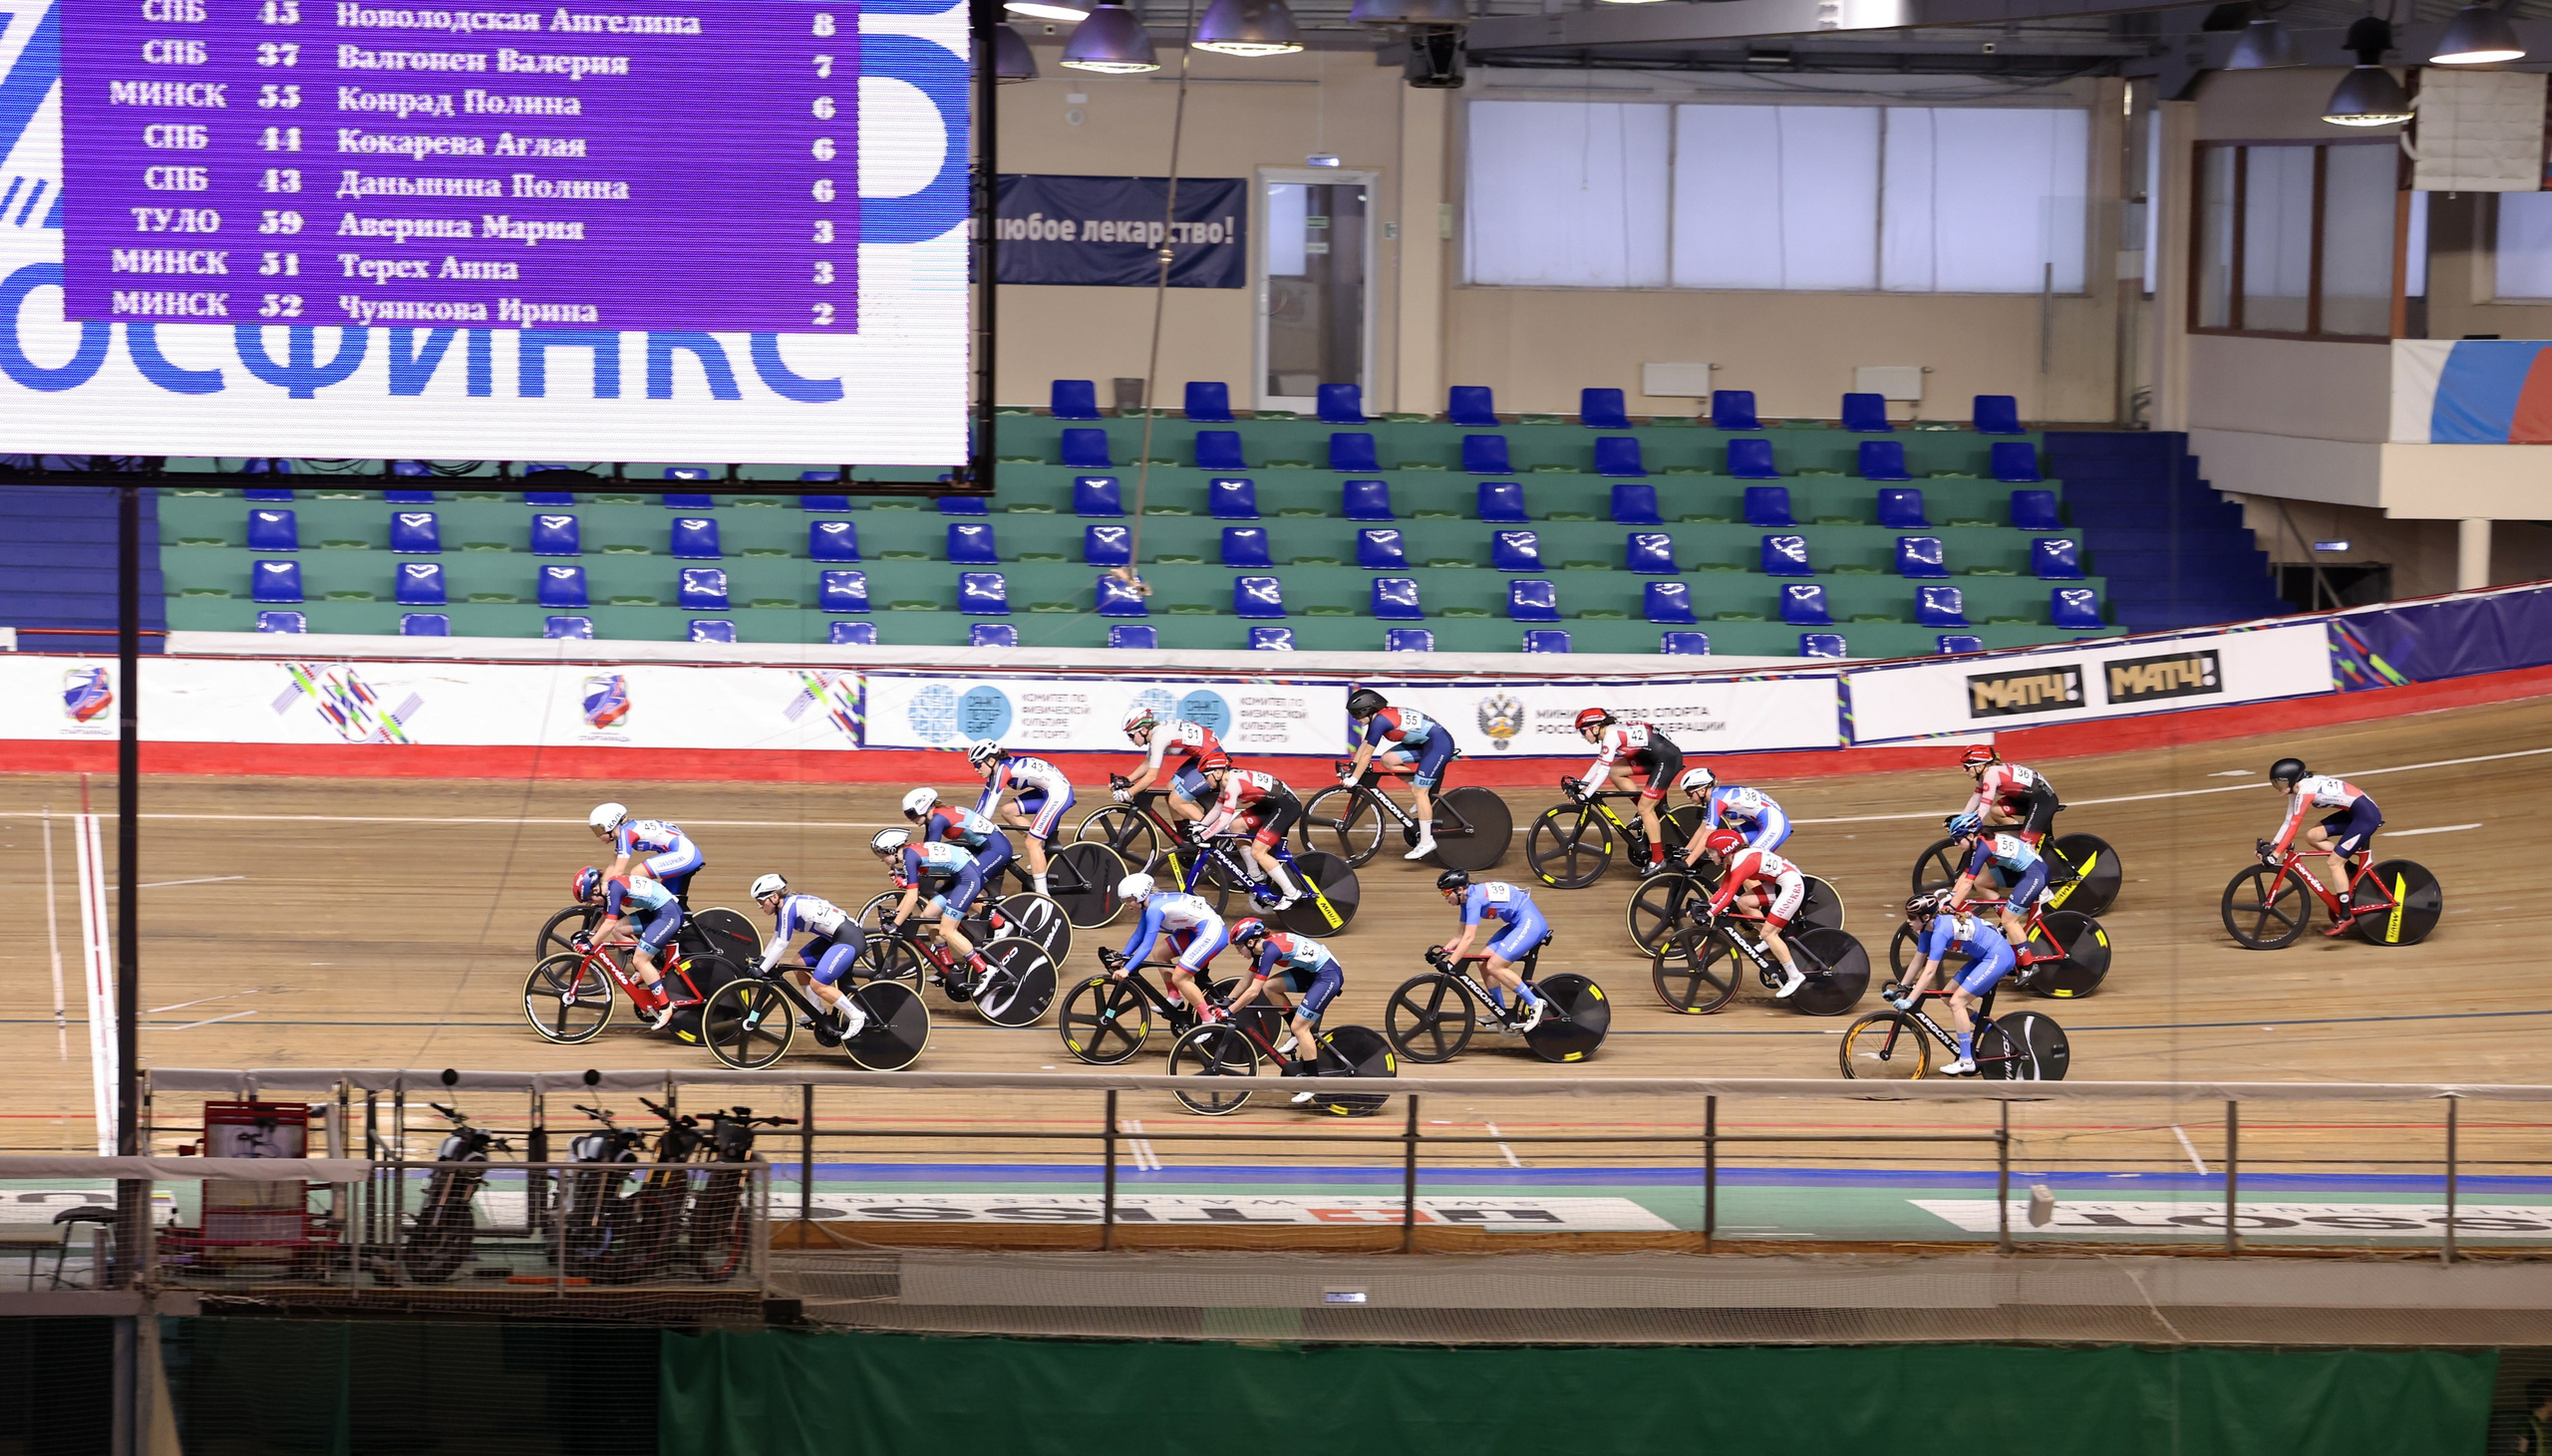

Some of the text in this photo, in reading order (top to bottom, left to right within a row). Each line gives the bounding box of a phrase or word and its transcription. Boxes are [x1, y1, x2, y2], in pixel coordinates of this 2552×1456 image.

[143, 0, 836, 37] СПБ 45 Новолодская Ангелина 8
[143, 39, 835, 82] СПБ 37 Валгонен Валерия 7
[110, 81, 836, 121] МИНСК 55 Конрад Полина 6
[144, 124, 836, 162] СПБ 44 Кокарева Аглая 6
[144, 165, 836, 203] СПБ 43 Даньшина Полина 6
[131, 207, 835, 246] ТУЛО 59 Аверина Мария 3
[111, 248, 835, 285] МИНСК 51 Терех Анна 3
[112, 291, 835, 329] МИНСК 52 Чуянкова Ирина 2
[2109, 657, 2217, 697] МАТЧ!
[1405, 715, 1419, 727] 55
[1187, 728, 1200, 739] 51
[1631, 730, 1644, 740] 42
[1031, 761, 1044, 772] 43
[2017, 767, 2030, 779] 36
[1257, 773, 1269, 783] 59
[2327, 780, 2339, 790] 41
[1745, 790, 1757, 802] 38
[1370, 787, 1404, 819] ARGON
[644, 822, 657, 831] 45
[933, 844, 946, 856] 52
[1721, 838, 1741, 855] KASK
[2002, 840, 2015, 852] 56
[1212, 848, 1256, 888] PINARELLO
[1765, 858, 1778, 871] 40
[635, 879, 648, 890] 57
[1491, 885, 1505, 896] 39
[1190, 899, 1203, 910] 44
[816, 905, 830, 918] 37
[1300, 946, 1315, 958] 54
[1724, 925, 1769, 970] ARGON 18
[1458, 974, 1506, 1018] ARGON 18
[1914, 1012, 1953, 1047] ARGON
